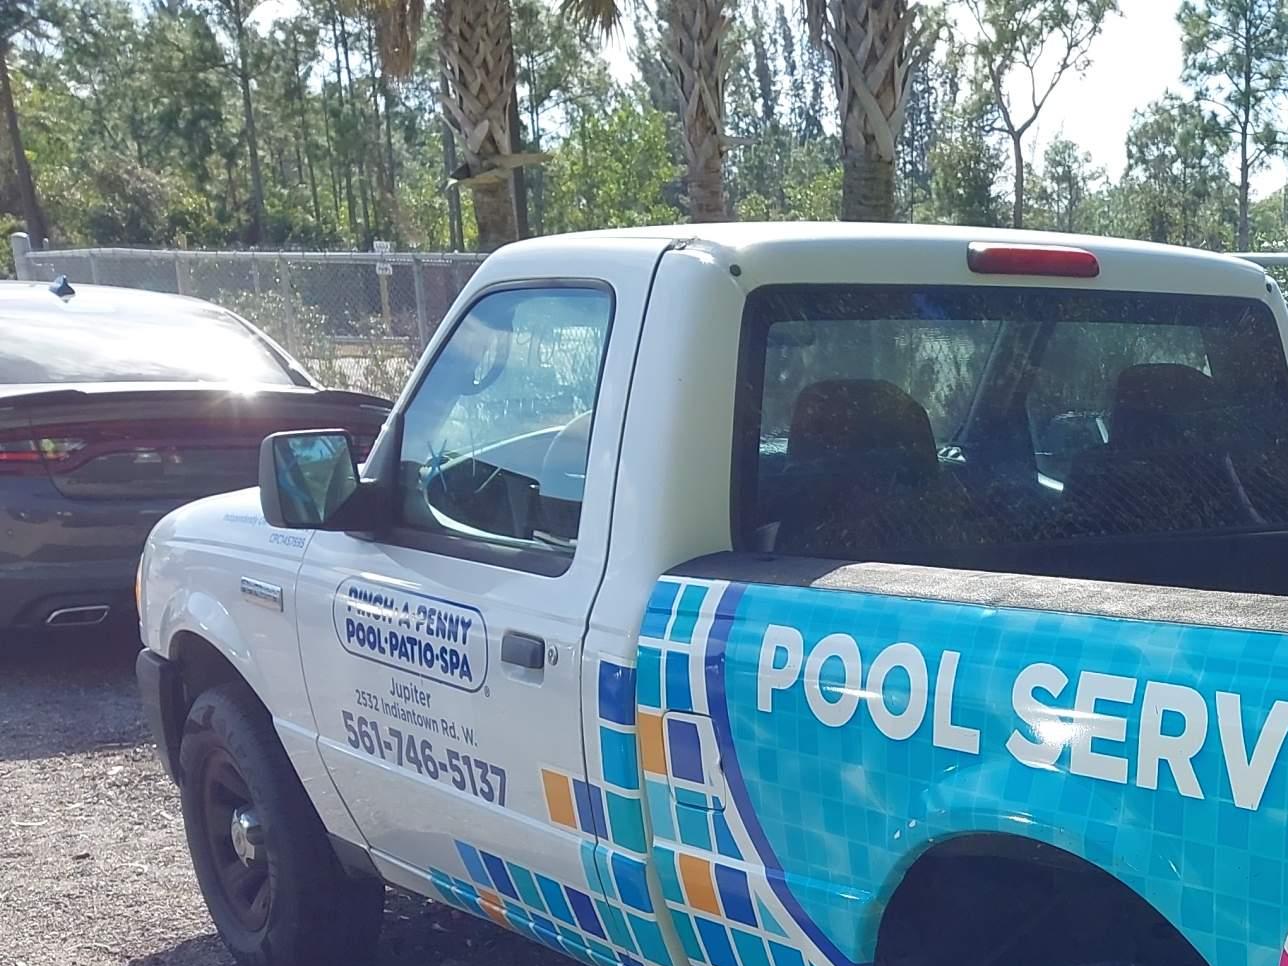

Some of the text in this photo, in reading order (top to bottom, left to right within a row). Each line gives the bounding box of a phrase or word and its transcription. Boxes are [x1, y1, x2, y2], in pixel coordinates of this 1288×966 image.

[355, 689, 478, 747] 2532 Indiantown Rd. W.
[390, 678, 431, 708] Jupiter
[756, 624, 981, 755] POOL
[341, 710, 506, 807] 561-746-5137
